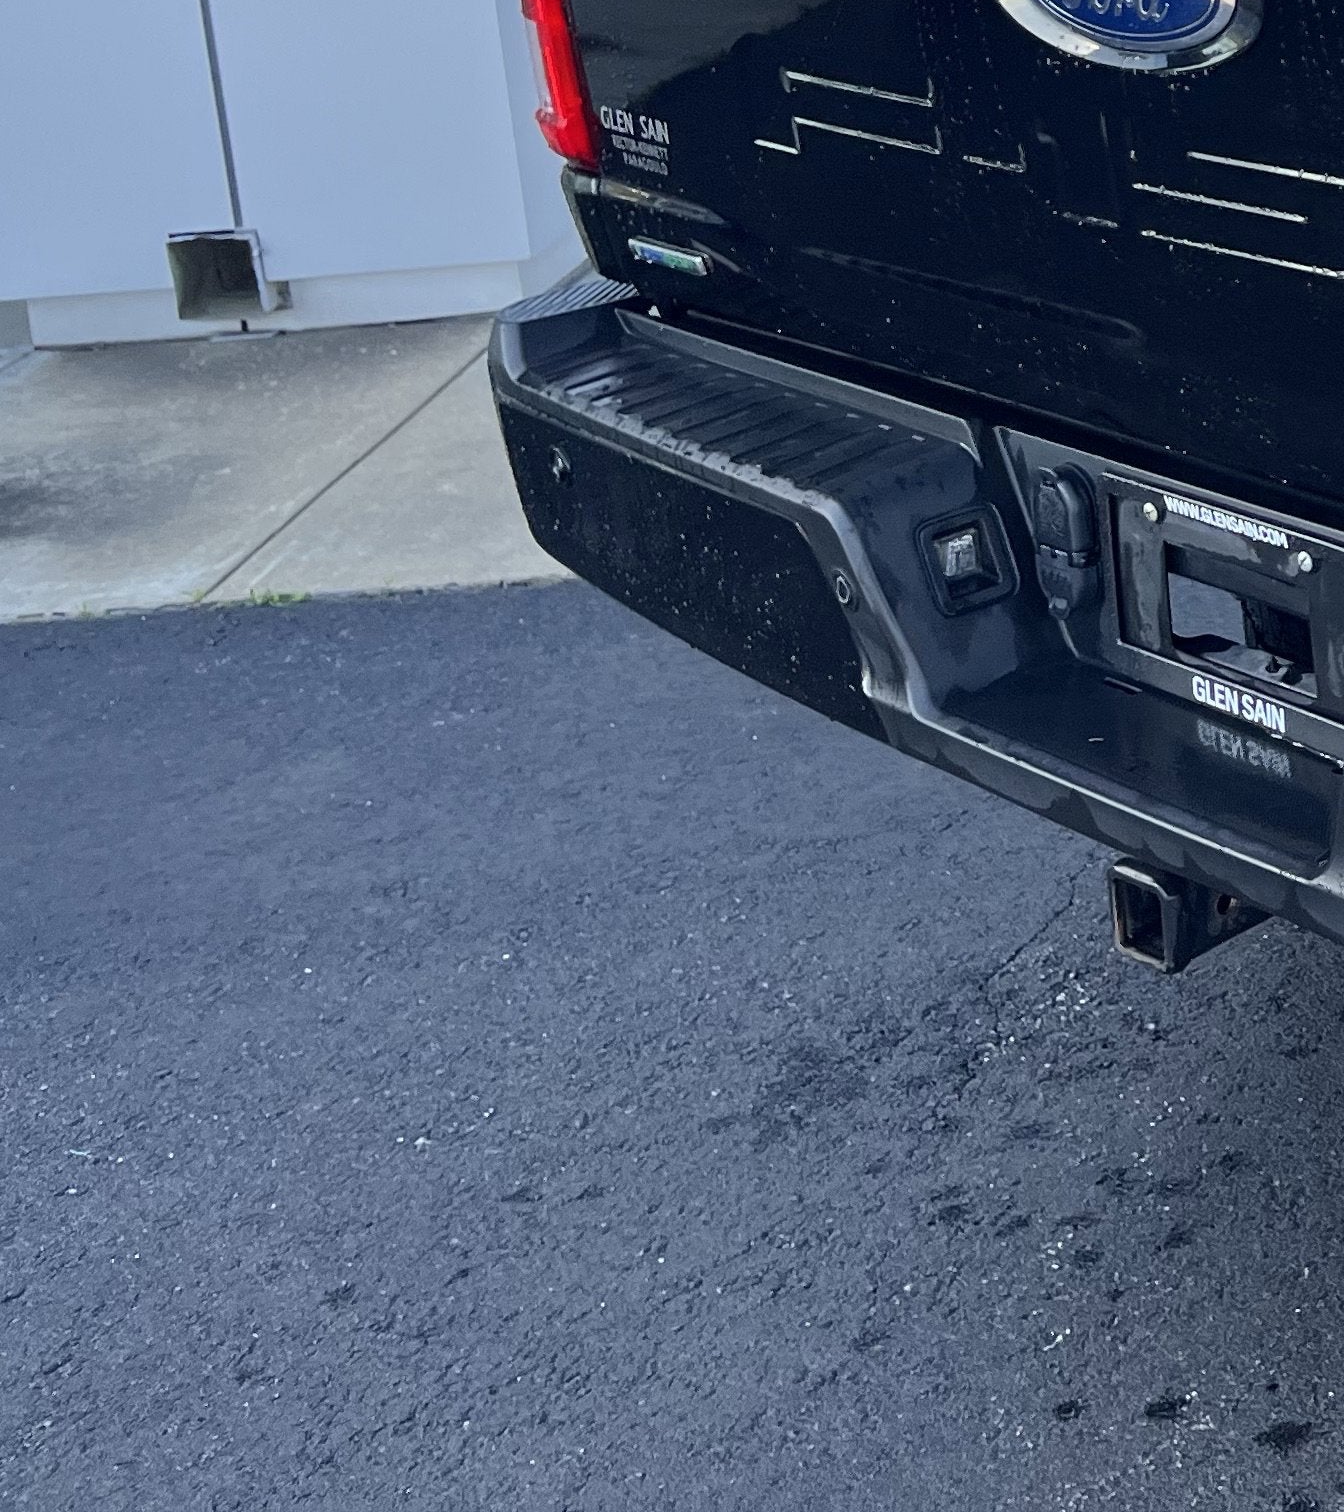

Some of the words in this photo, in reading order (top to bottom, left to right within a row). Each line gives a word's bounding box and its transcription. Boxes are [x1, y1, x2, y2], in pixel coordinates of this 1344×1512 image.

[600, 104, 634, 136] GLEN
[638, 114, 670, 145] SAIN
[1162, 494, 1289, 550] WWW.GLENSAIN.COM
[1191, 675, 1239, 716] GLEN
[1241, 696, 1286, 734] SAIN
